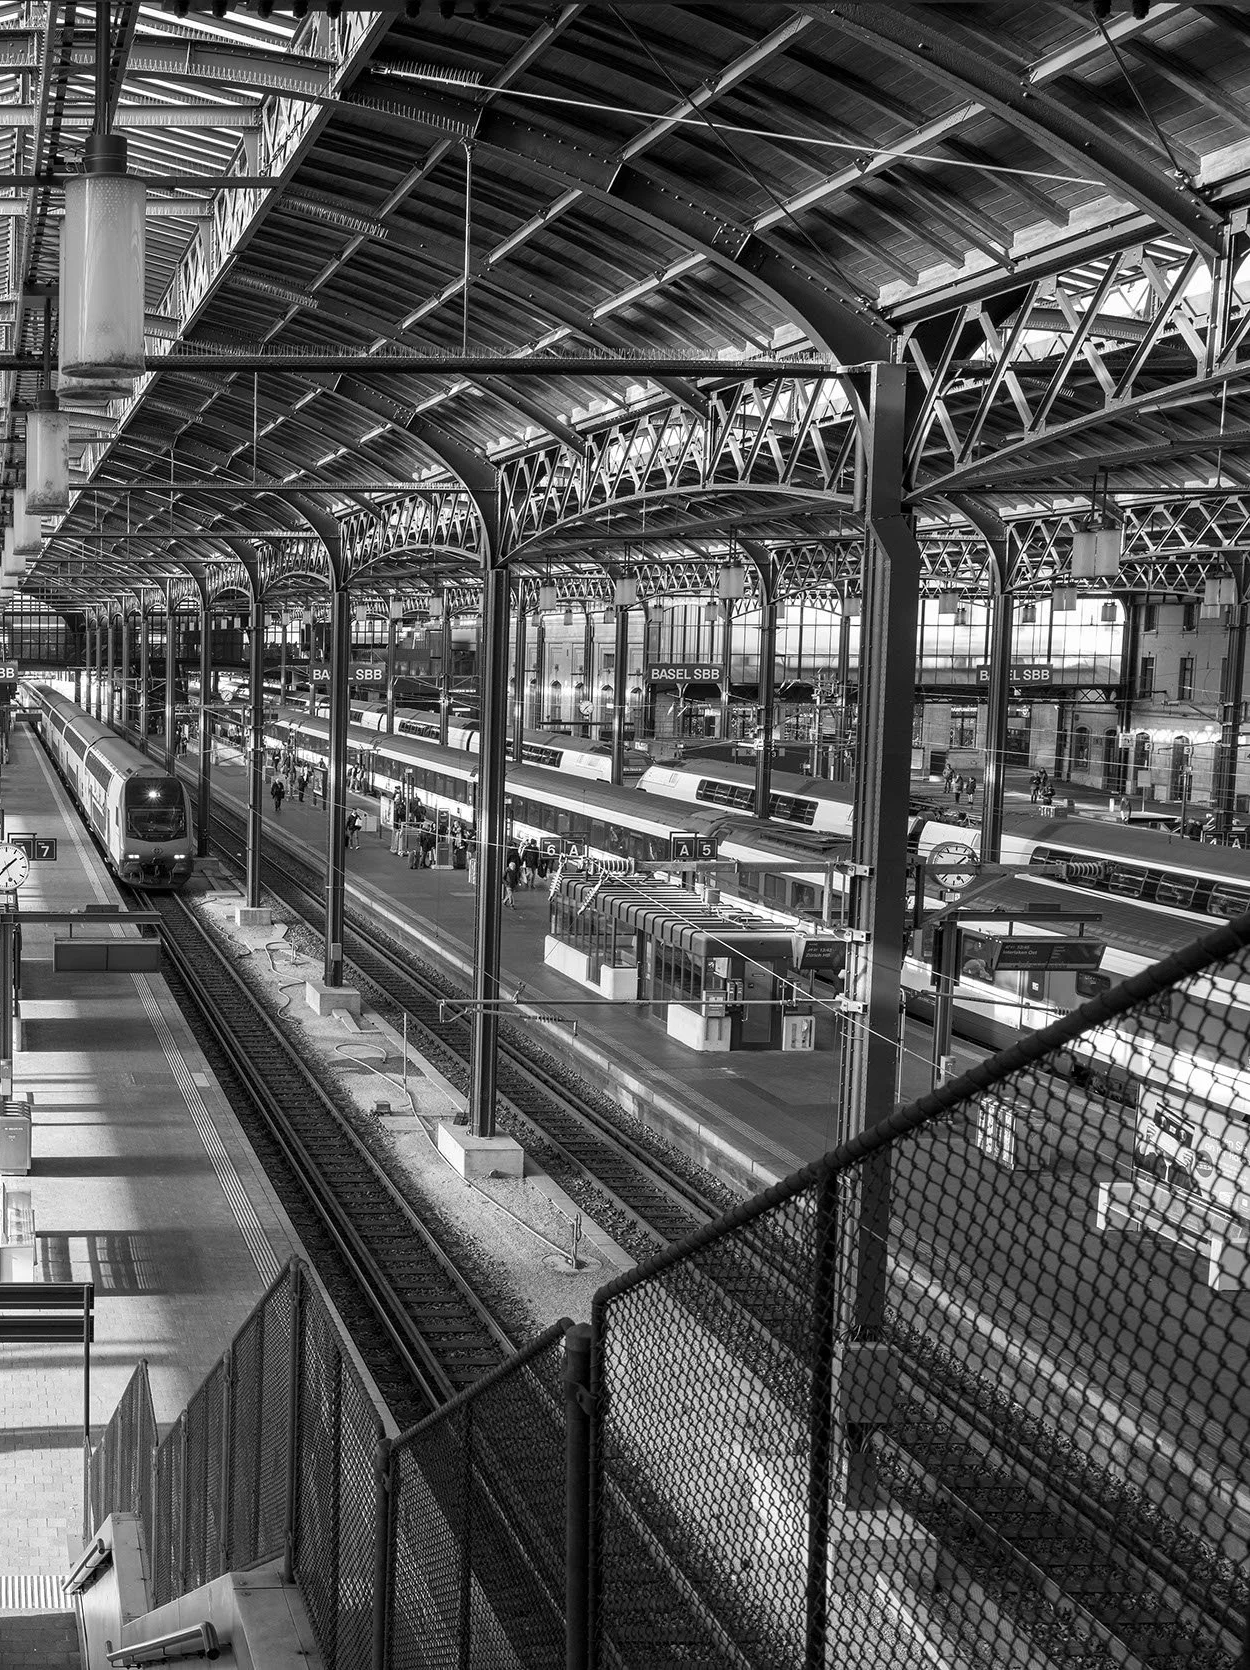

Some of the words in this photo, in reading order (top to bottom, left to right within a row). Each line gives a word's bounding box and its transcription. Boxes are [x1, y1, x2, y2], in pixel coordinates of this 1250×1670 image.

[355, 669, 383, 680] SBB
[651, 668, 691, 680] BASEL
[693, 668, 720, 680] SBB
[1022, 669, 1050, 681] SBB
[1231, 837, 1241, 849] A
[41, 845, 50, 857] 7
[547, 844, 556, 856] 6
[569, 845, 579, 856] A
[679, 845, 689, 856] A
[702, 845, 711, 856] 5
